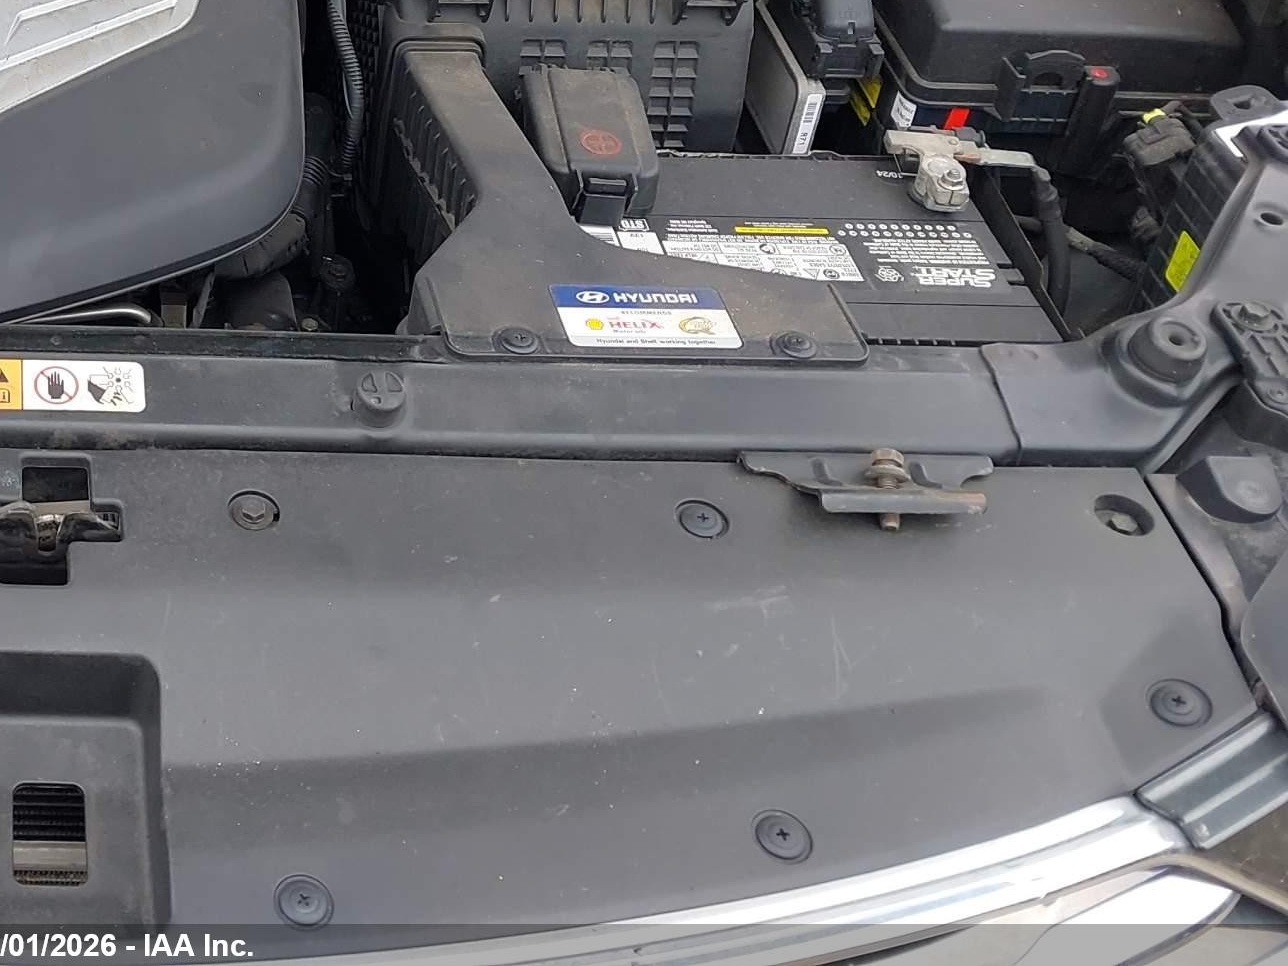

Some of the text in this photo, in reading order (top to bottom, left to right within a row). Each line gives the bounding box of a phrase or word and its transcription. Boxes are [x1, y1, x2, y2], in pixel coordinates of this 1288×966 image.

[917, 268, 995, 280] START
[919, 276, 991, 288] SUPER
[613, 292, 698, 304] HYUNDAI
[609, 320, 663, 329] HELIX
